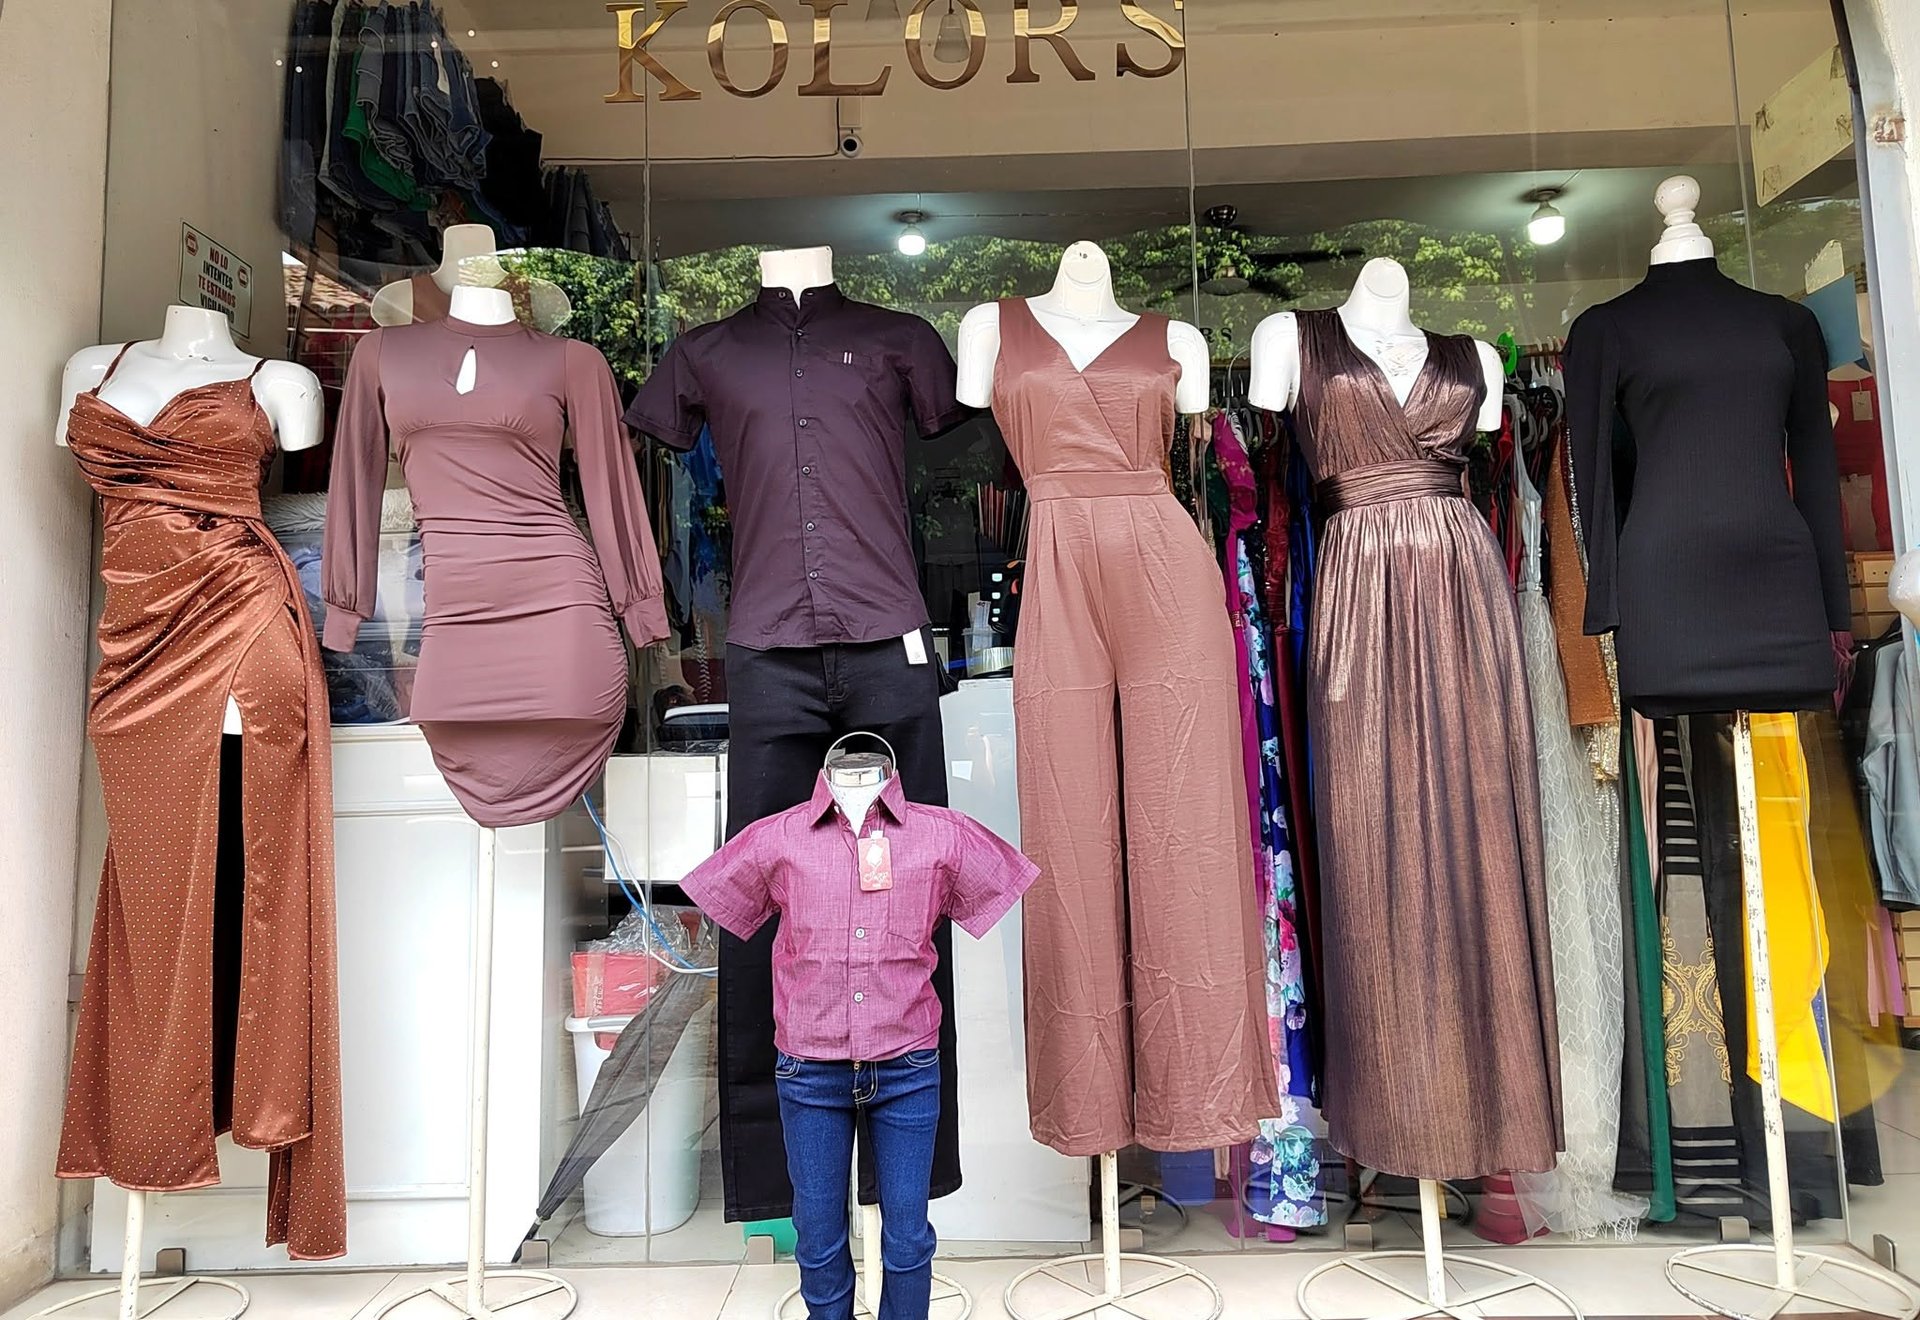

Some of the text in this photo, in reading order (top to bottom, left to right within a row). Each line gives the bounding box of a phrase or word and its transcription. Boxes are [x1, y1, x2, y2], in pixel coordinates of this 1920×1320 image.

[604, 0, 1184, 103] KOLORS
[210, 247, 228, 270] NO LO
[198, 274, 236, 308] TE ESTAMOS
[203, 260, 233, 290] INTENTES
